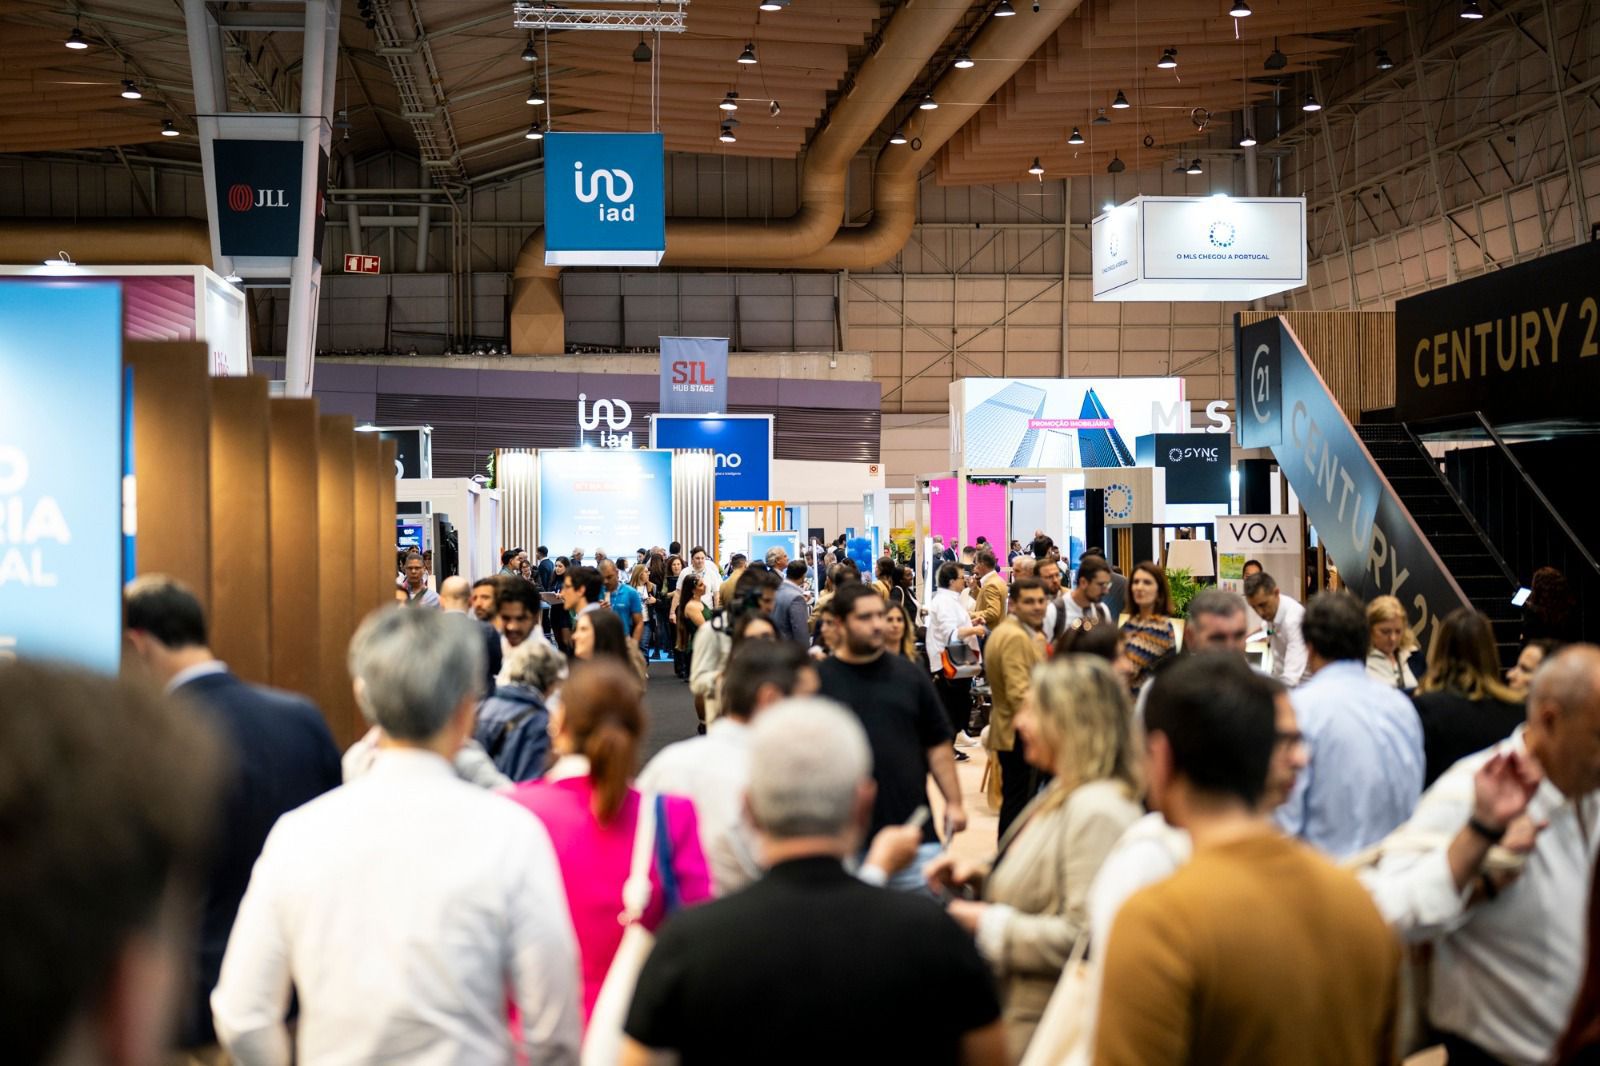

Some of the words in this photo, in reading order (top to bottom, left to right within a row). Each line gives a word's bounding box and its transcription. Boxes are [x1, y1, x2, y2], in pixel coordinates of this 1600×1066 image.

[254, 189, 289, 207] JLL
[599, 203, 635, 222] iad
[1414, 302, 1568, 388] CENTURY
[672, 361, 715, 385] SIL
[673, 384, 689, 392] HUB
[690, 384, 714, 393] STAGE
[1152, 400, 1232, 434] MLS
[601, 431, 632, 449] iad
[1184, 447, 1218, 458] SYNC
